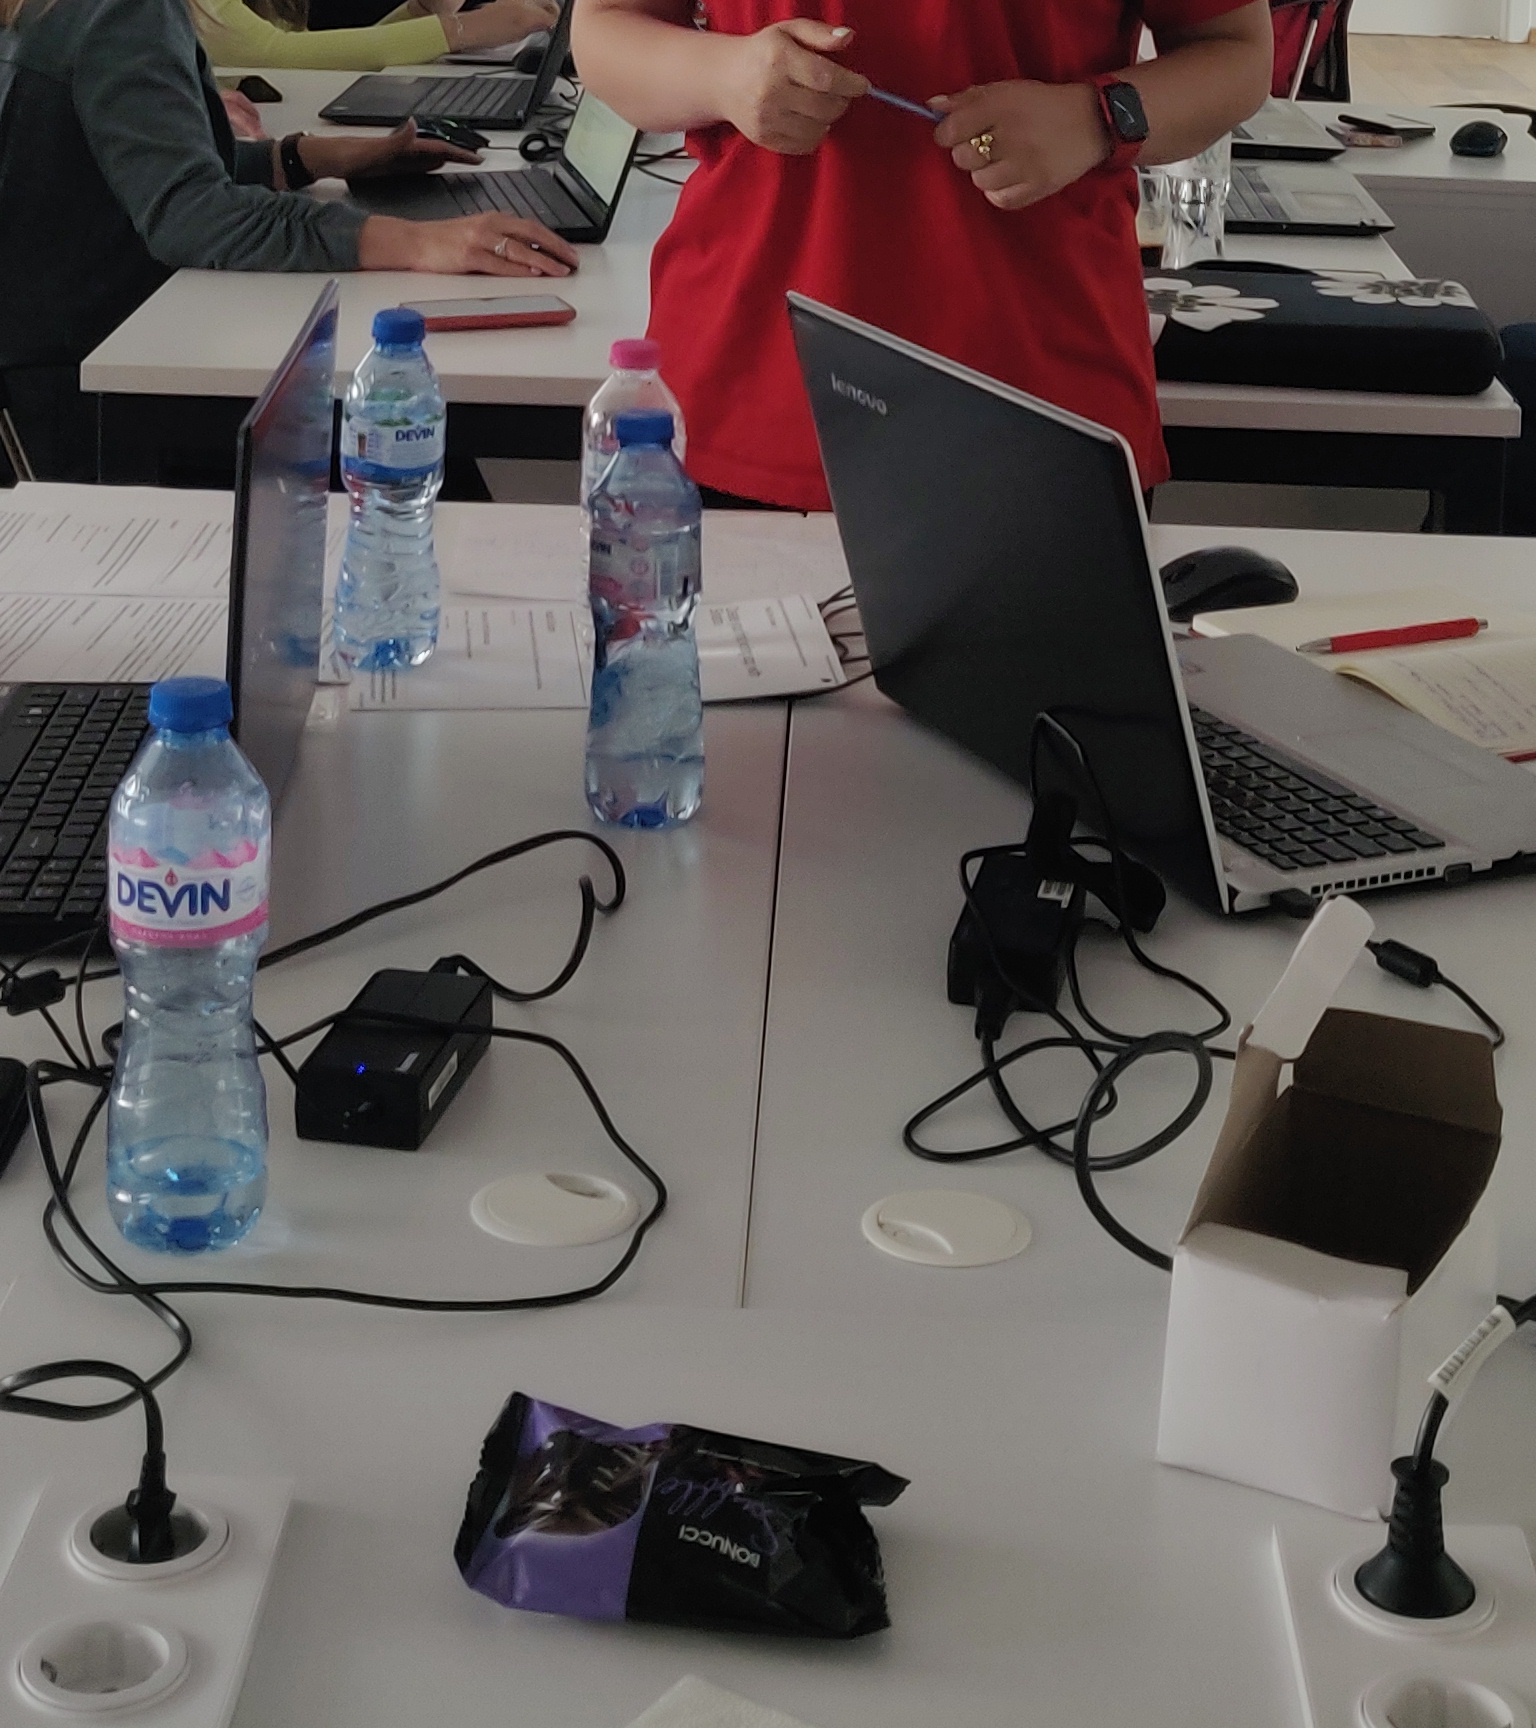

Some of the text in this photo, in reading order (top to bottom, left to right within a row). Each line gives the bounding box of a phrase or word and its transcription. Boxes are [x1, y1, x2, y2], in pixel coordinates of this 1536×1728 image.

[831, 371, 887, 416] lenovo
[394, 425, 436, 442] DEVIN
[117, 871, 231, 919] DEVIN
[677, 1523, 761, 1569] BONUCCI
